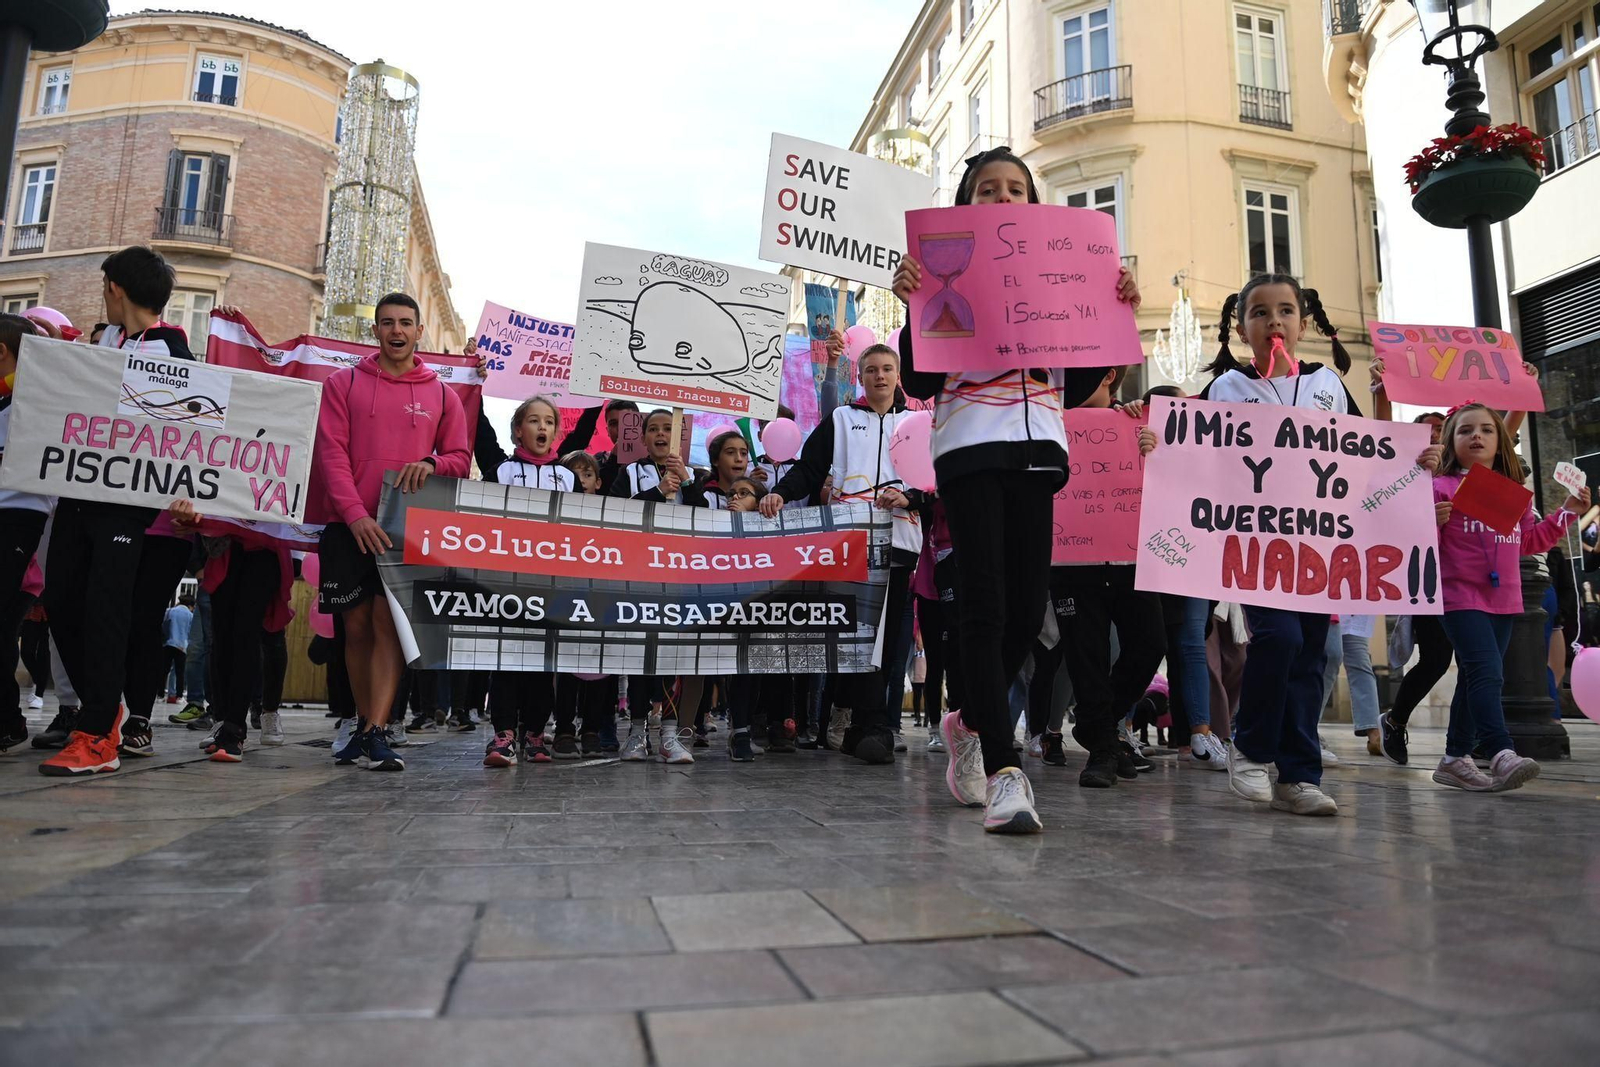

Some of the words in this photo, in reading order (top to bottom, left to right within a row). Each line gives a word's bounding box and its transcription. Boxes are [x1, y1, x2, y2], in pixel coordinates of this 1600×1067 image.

[784, 154, 850, 190] SAVE
[777, 188, 836, 222] OUR
[776, 222, 900, 271] SWIMMER
[1048, 237, 1073, 251] NOS
[1087, 243, 1114, 255] AGOTA
[1004, 275, 1022, 287] EL
[1038, 273, 1086, 285] TIEMPO
[1074, 304, 1098, 321] YA!
[128, 355, 190, 380] inacua
[475, 353, 505, 370] ÁS
[148, 374, 189, 389] málaga
[600, 380, 669, 397] ¡Solución
[676, 389, 722, 405] Inacua
[728, 397, 749, 409] Ya!
[62, 412, 290, 478] REPARACIÓN
[623, 428, 639, 440] ES
[40, 446, 220, 500] PISCINAS
[1092, 461, 1111, 473] DE
[1119, 461, 1133, 471] LA
[1242, 455, 1273, 493] Y
[249, 477, 300, 518] YA!
[1096, 489, 1105, 498] A
[1085, 504, 1105, 514] LAS
[1190, 497, 1354, 539] QUEREMOS
[420, 526, 623, 566] ¡Solución
[647, 545, 775, 570] Inacua
[794, 541, 849, 567] Ya!
[1167, 528, 1196, 553] CDN
[1222, 534, 1438, 605] NADAR!!
[424, 590, 545, 621] VAMOS
[569, 599, 595, 623] A
[617, 601, 850, 626] DESAPARECER
